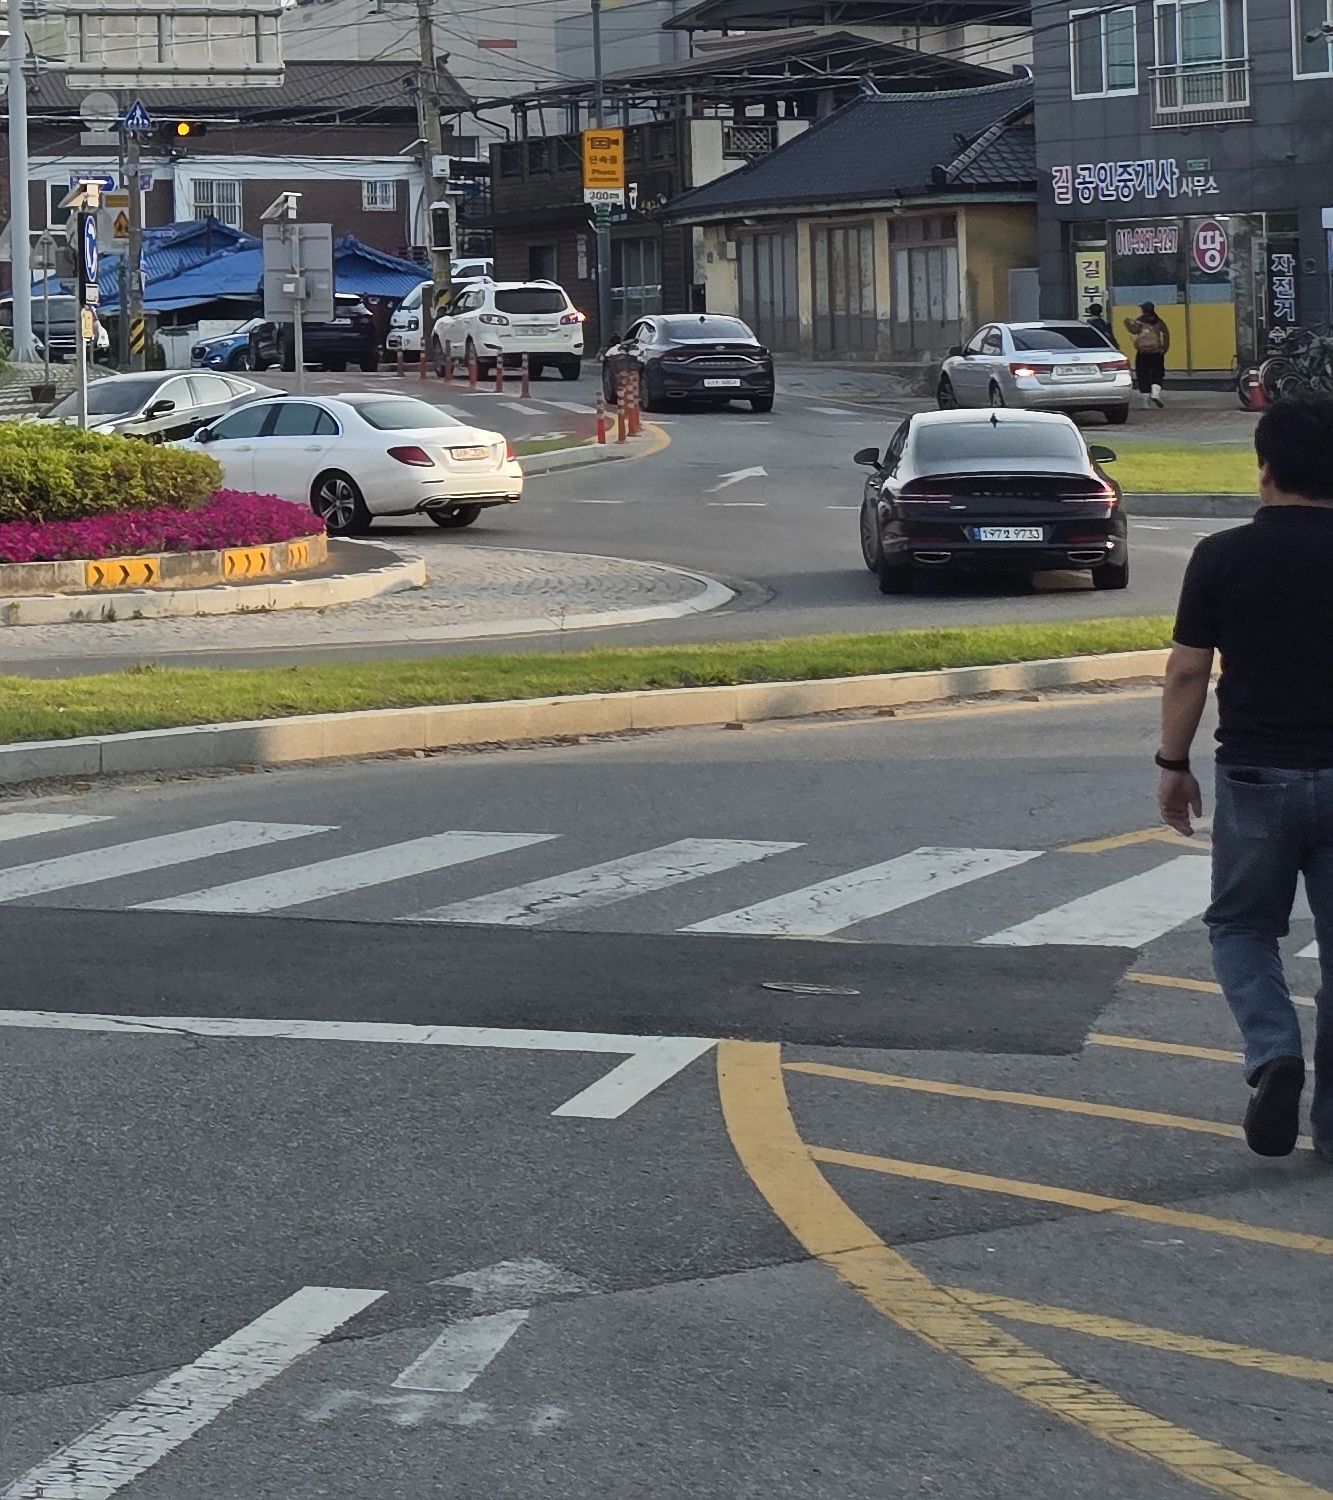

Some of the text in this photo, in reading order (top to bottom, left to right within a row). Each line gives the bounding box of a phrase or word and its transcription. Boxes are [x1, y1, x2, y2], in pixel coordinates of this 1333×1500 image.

[1052, 159, 1220, 205] 길 공인중개사 사무소
[1082, 260, 1100, 279] 길
[1198, 230, 1224, 268] 땅
[1271, 253, 1296, 322] 자전거
